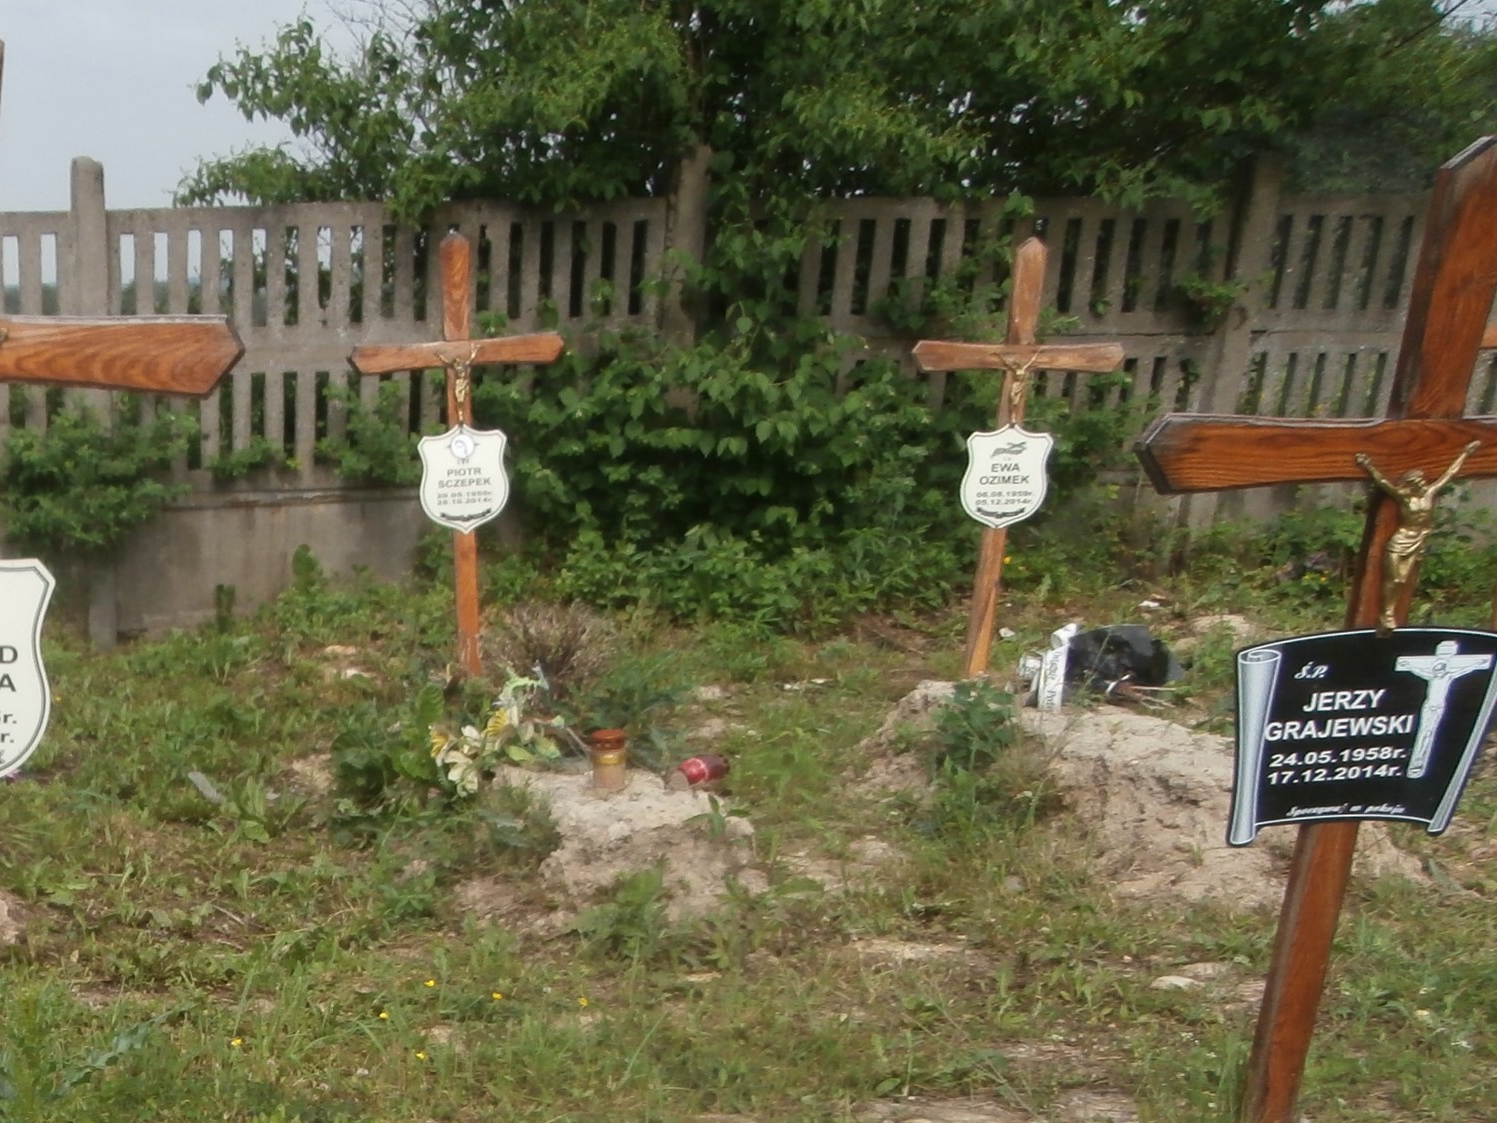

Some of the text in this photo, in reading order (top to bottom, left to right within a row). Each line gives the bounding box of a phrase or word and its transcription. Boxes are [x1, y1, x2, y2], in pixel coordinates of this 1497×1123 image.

[446, 467, 482, 477] PIOTR
[990, 463, 1021, 473] EWA
[438, 477, 492, 489] SCZEPEK
[979, 475, 1031, 485] OZIMEK
[1302, 689, 1386, 713] JERZY
[1265, 714, 1414, 742] GRAJEWSKI
[1268, 746, 1407, 768] 24.05.1958r.
[1266, 765, 1402, 786] 17.12.2014r.
